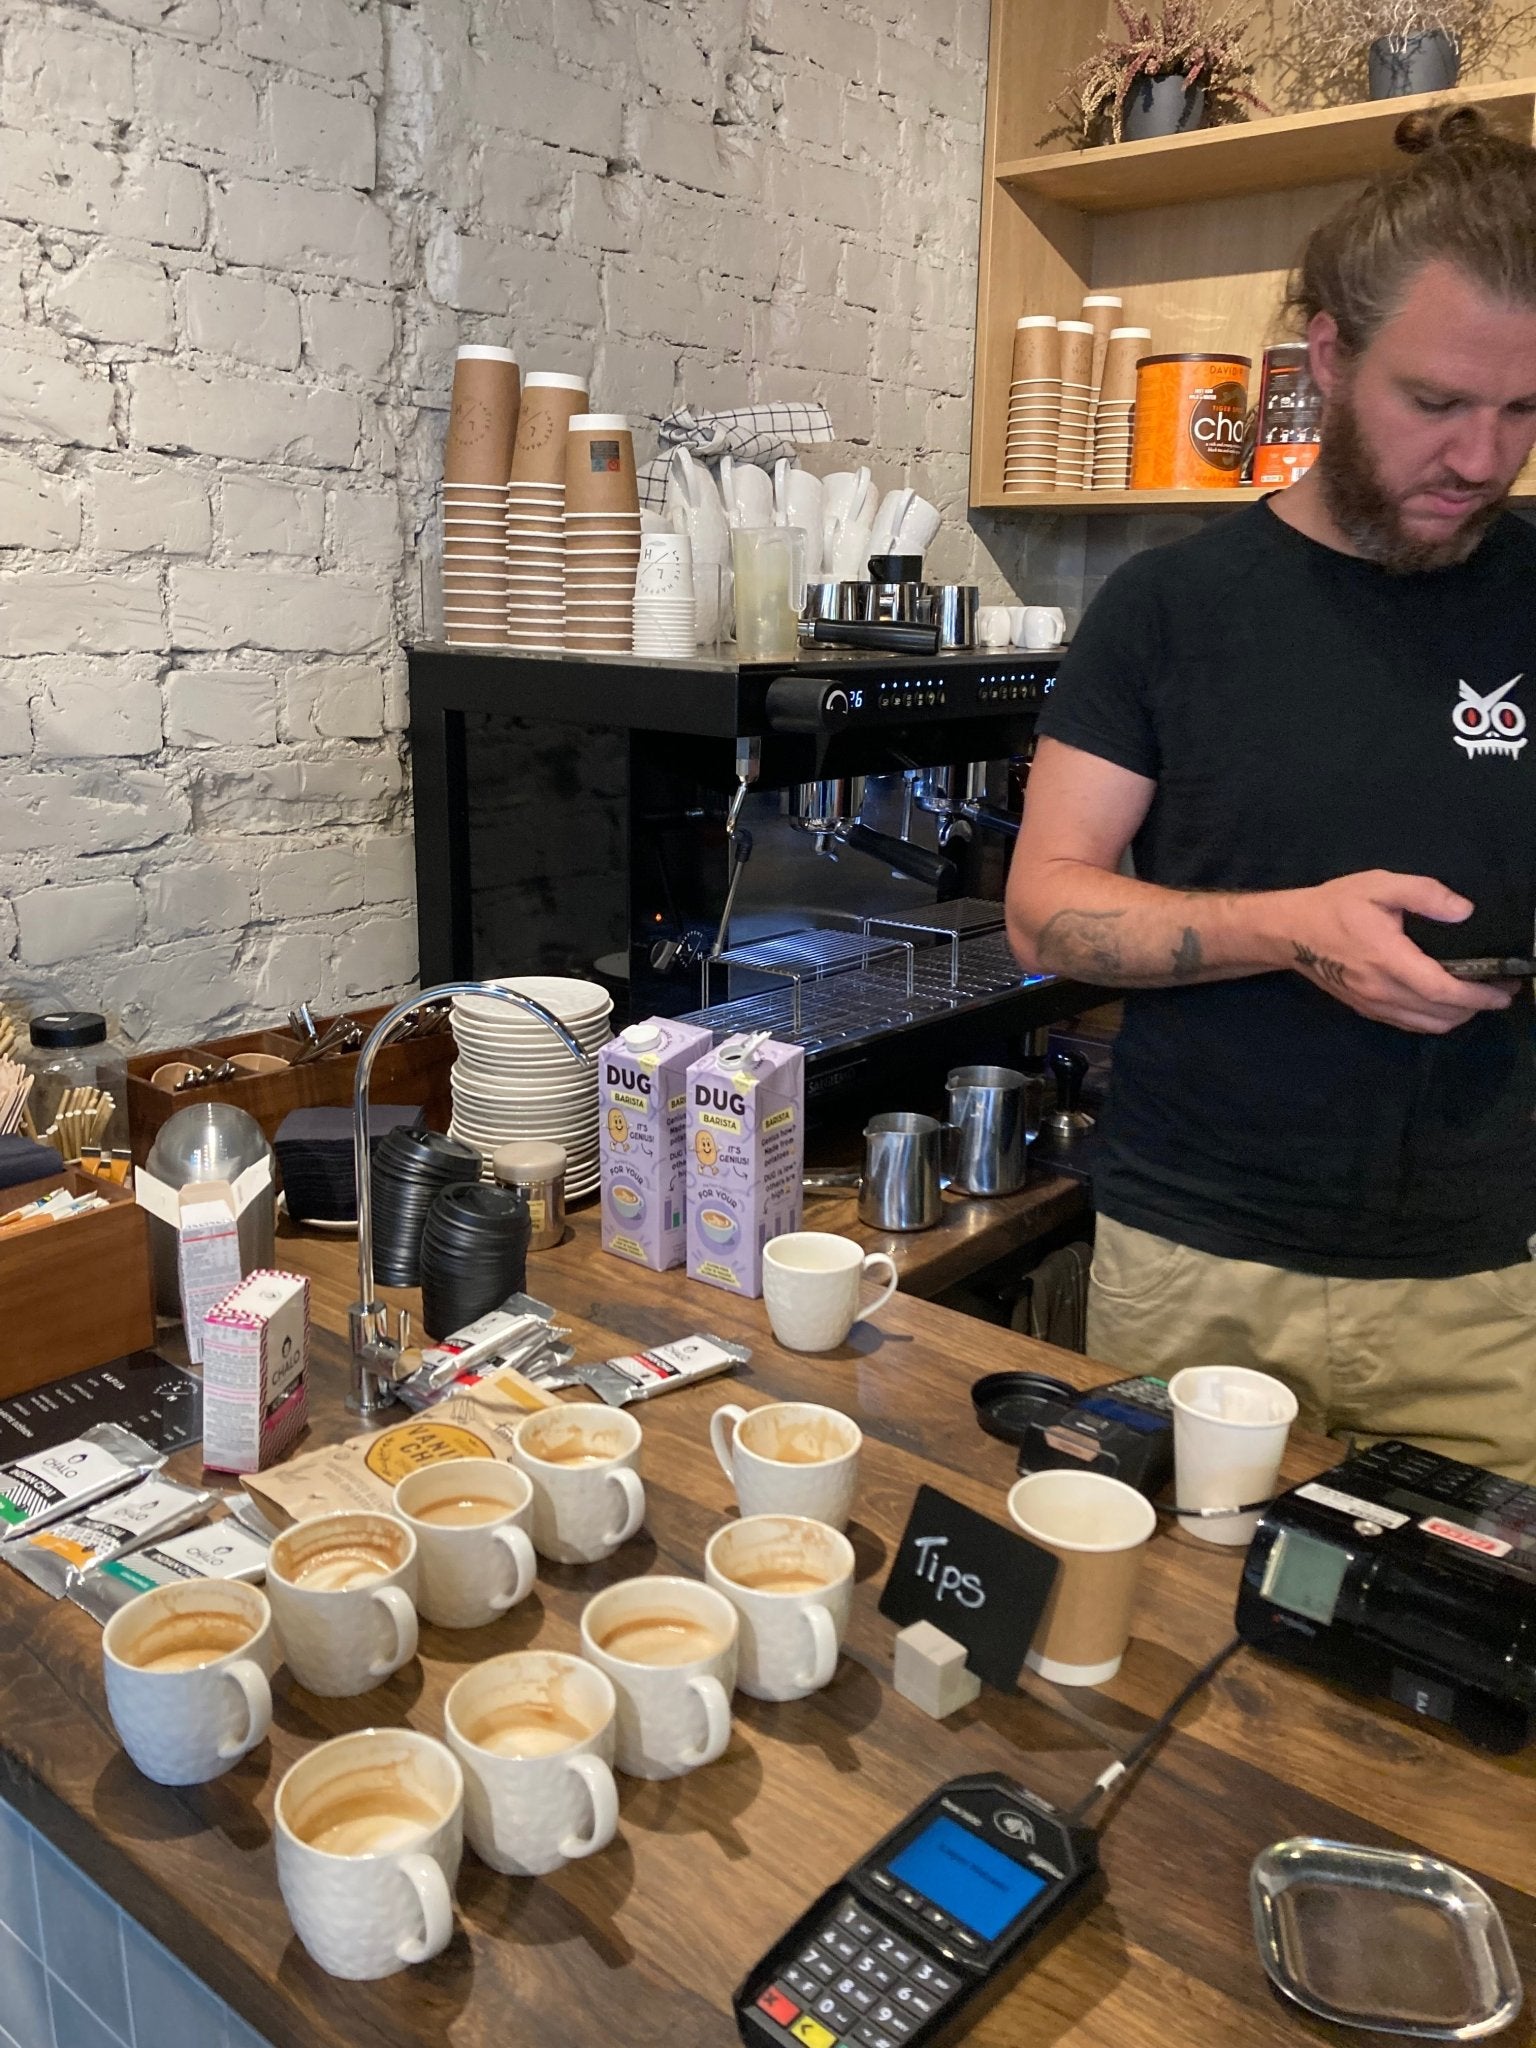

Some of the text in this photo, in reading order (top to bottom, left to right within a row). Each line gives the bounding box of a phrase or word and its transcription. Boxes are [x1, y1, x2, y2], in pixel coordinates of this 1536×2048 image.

[1209, 365, 1237, 376] DAVID
[1193, 411, 1244, 441] cha
[607, 1064, 652, 1095] DUG
[614, 1093, 645, 1109] BARISTA
[671, 1096, 686, 1108] BARI
[695, 1084, 746, 1116] DUG
[703, 1114, 737, 1130] BARISTA
[765, 1111, 790, 1128] BARISTA
[629, 1132, 655, 1143] GENIUS!
[727, 1145, 741, 1155] IT'S
[719, 1154, 750, 1165] GENIUS!
[610, 1165, 624, 1176] FOR
[625, 1166, 644, 1184] YOUR
[698, 1189, 738, 1208] FOR YOUR
[271, 1350, 301, 1386] CHALO
[407, 1425, 463, 1458] VANI
[400, 1443, 430, 1462] CH
[42, 1457, 78, 1479] CHALO
[915, 1536, 986, 1609] Tips
[843, 1909, 857, 1924] 1
[823, 1931, 837, 1944] 4
[878, 1937, 895, 1952] 2
[802, 1949, 819, 1964] 7
[858, 1957, 874, 1972] 5
[916, 1966, 933, 1981] 3
[838, 1979, 855, 1994] 8
[897, 1986, 912, 2001] 6
[819, 1998, 835, 2014] 0
[878, 2006, 893, 2021] 9
